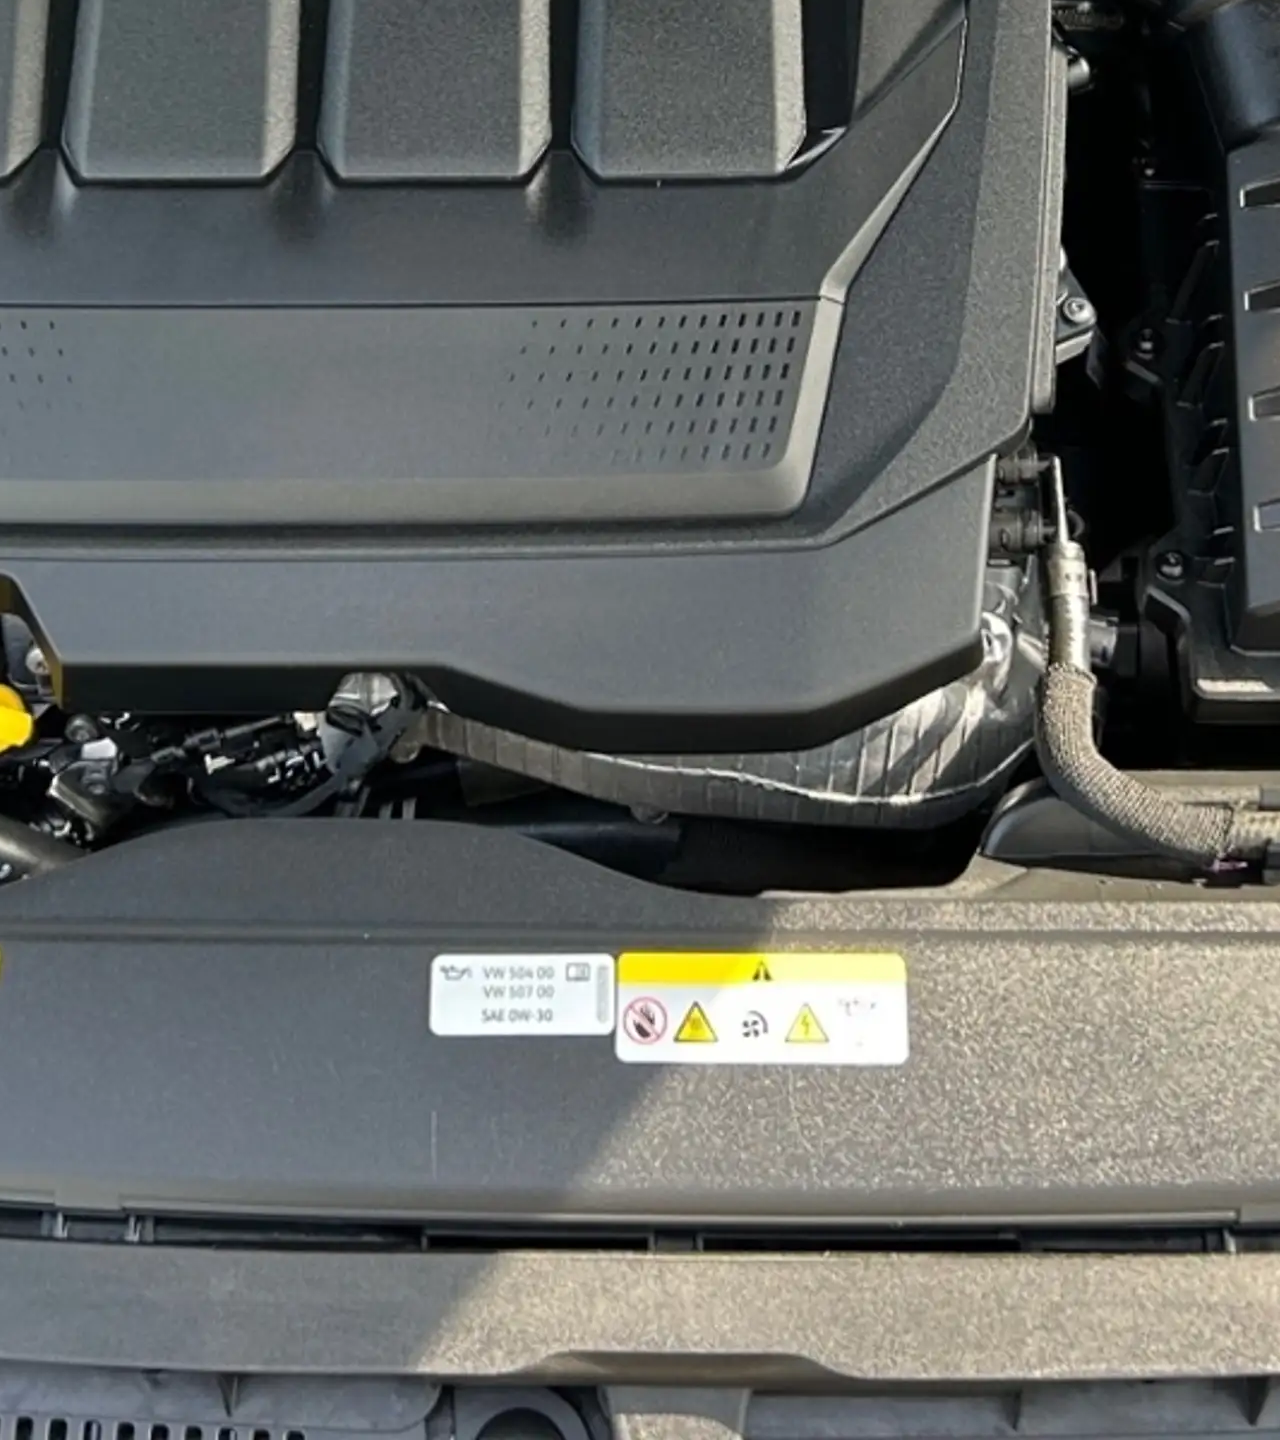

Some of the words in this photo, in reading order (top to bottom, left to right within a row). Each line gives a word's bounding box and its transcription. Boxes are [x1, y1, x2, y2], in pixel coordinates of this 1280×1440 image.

[482, 965, 506, 980] VW
[508, 965, 534, 980] 504
[536, 965, 555, 980] 00
[482, 984, 506, 998] VW
[508, 984, 534, 998] 507
[536, 984, 555, 998] 00
[480, 1007, 505, 1023] SAE
[507, 1007, 554, 1023] 0W-30
